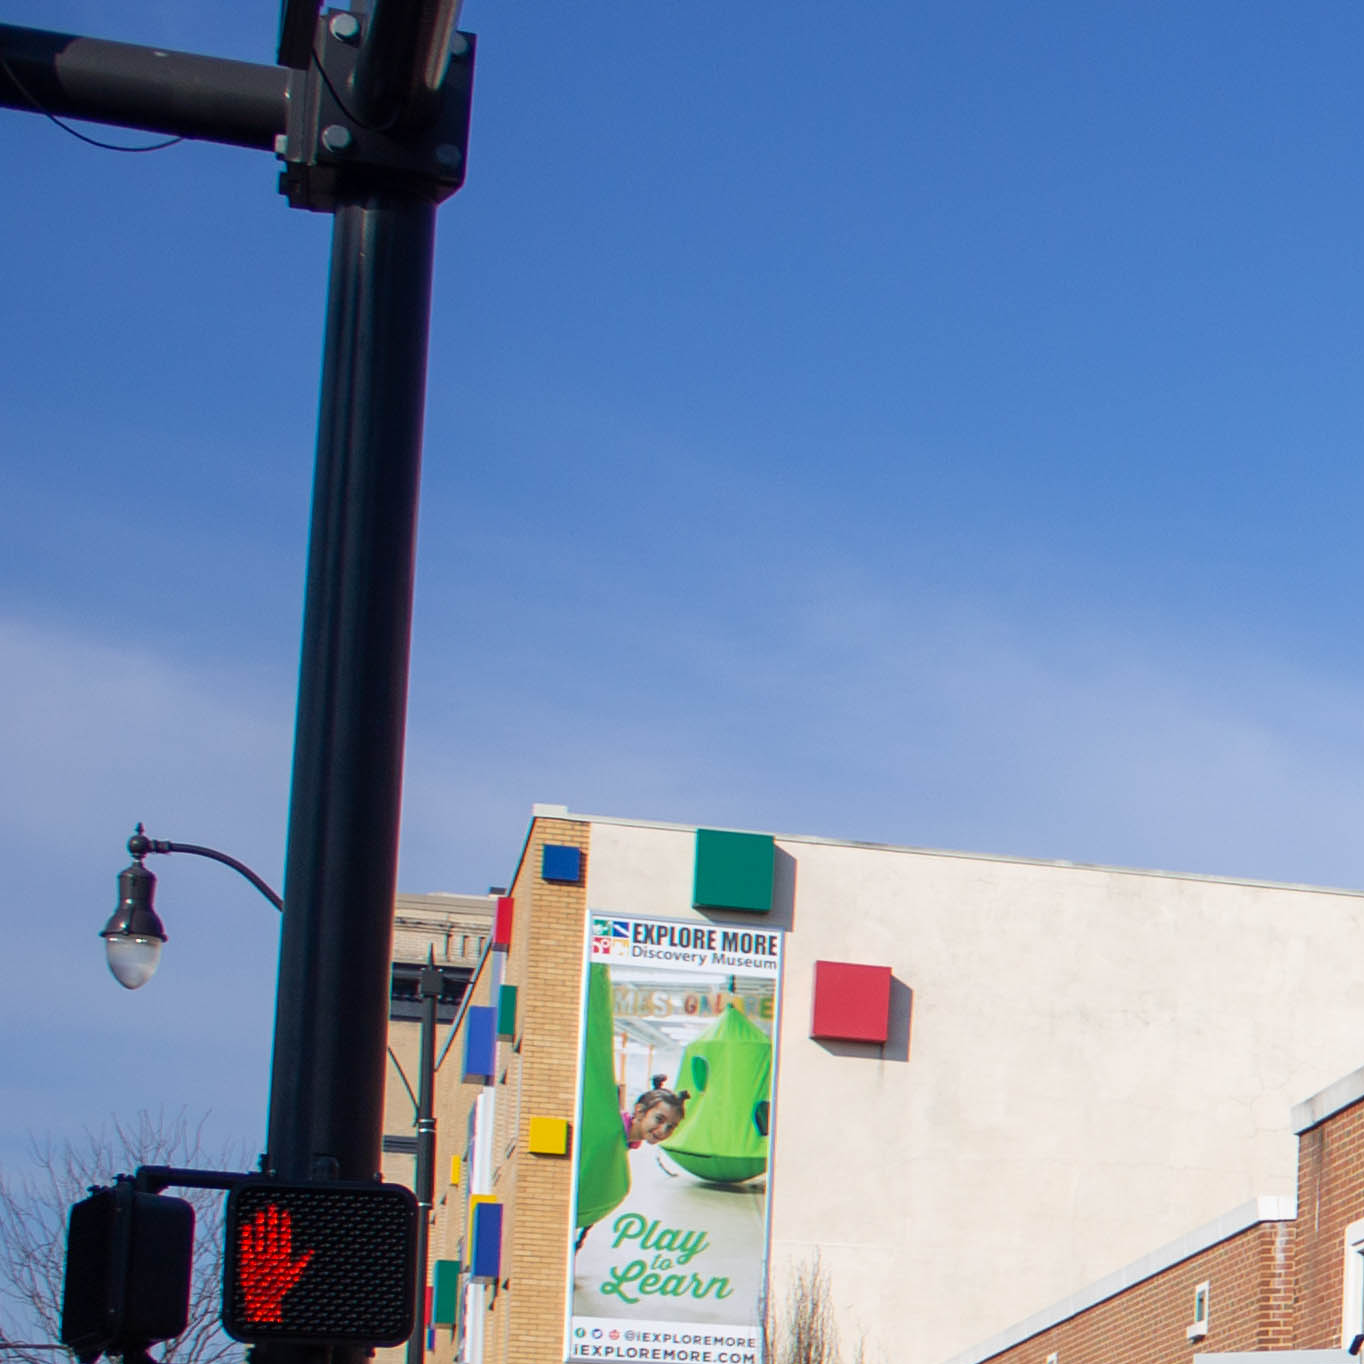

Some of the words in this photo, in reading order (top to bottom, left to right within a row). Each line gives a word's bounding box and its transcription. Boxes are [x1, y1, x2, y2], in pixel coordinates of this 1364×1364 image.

[632, 922, 717, 950] EXPLORE
[722, 931, 778, 956] MORE
[632, 945, 707, 966] Discovery
[712, 952, 777, 969] Museum
[611, 1213, 711, 1265] Play
[650, 1254, 673, 1271] to
[600, 1260, 734, 1304] Learn
[624, 1330, 756, 1348] @iEXPLOREMORE
[573, 1344, 756, 1364] iEXPLOREMORE.COM
